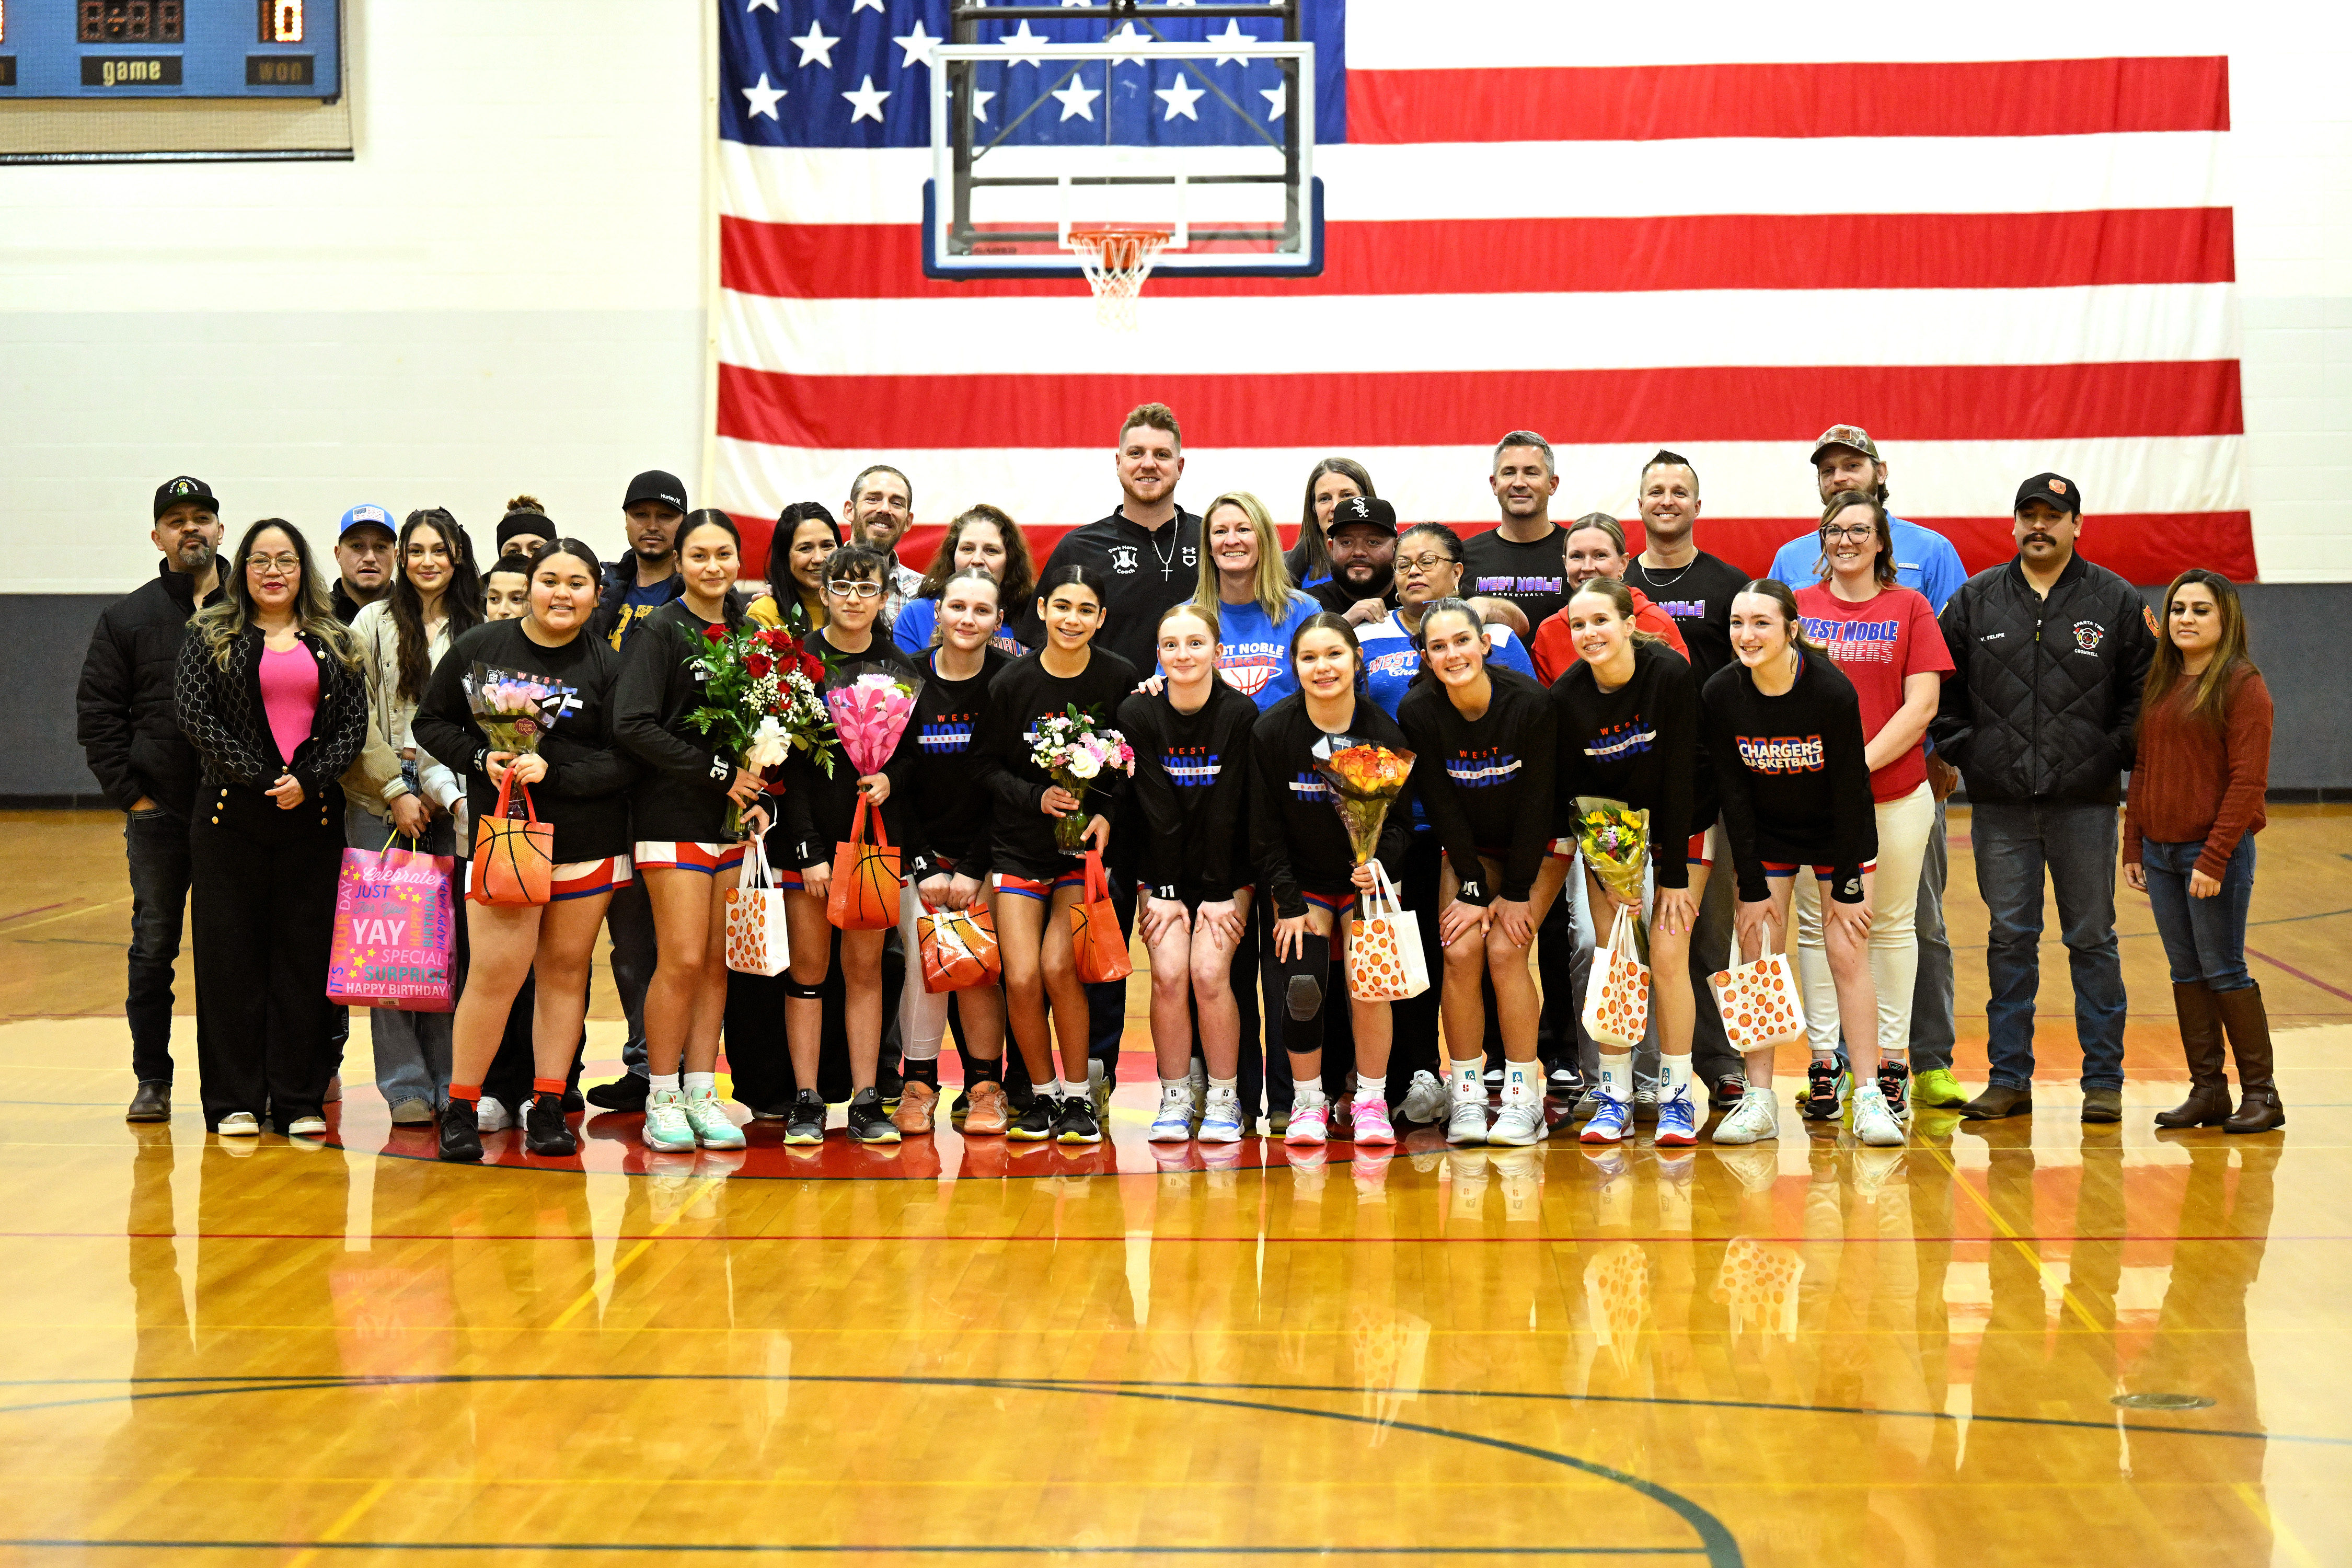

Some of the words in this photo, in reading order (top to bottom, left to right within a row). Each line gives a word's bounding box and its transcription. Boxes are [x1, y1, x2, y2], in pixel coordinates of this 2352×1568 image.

[103, 60, 161, 86] game
[260, 63, 302, 82] won
[661, 493, 676, 503] Hurley
[1478, 577, 1514, 592] WEST
[1517, 577, 1561, 592] NOBLE
[1658, 601, 1703, 617] NOBLE
[1842, 620, 1899, 642] NOBLE
[2094, 622, 2105, 632] TWP
[1222, 644, 1235, 656] ST
[1239, 642, 1285, 656] NOBLE
[2074, 649, 2099, 657] CROMWELL
[1369, 651, 1418, 676] WEST
[938, 713, 978, 722] WES
[1045, 710, 1088, 720] WET
[1460, 747, 1498, 759] WEST
[1739, 741, 1823, 758] CHARGERS
[1742, 754, 1825, 769] BASKETBALL
[363, 865, 436, 885] Celebrate
[355, 885, 391, 898] JUST
[1159, 885, 1174, 898] 11
[423, 888, 437, 948] BIRTHDAY
[330, 966, 343, 994] IT'S
[339, 879, 353, 910] DAY
[353, 919, 406, 946] YAY
[382, 949, 443, 966] SPECIAL
[364, 965, 447, 984] SURPRISE
[347, 983, 386, 994] HAPPY
[389, 983, 446, 997] BIRTHDAY
